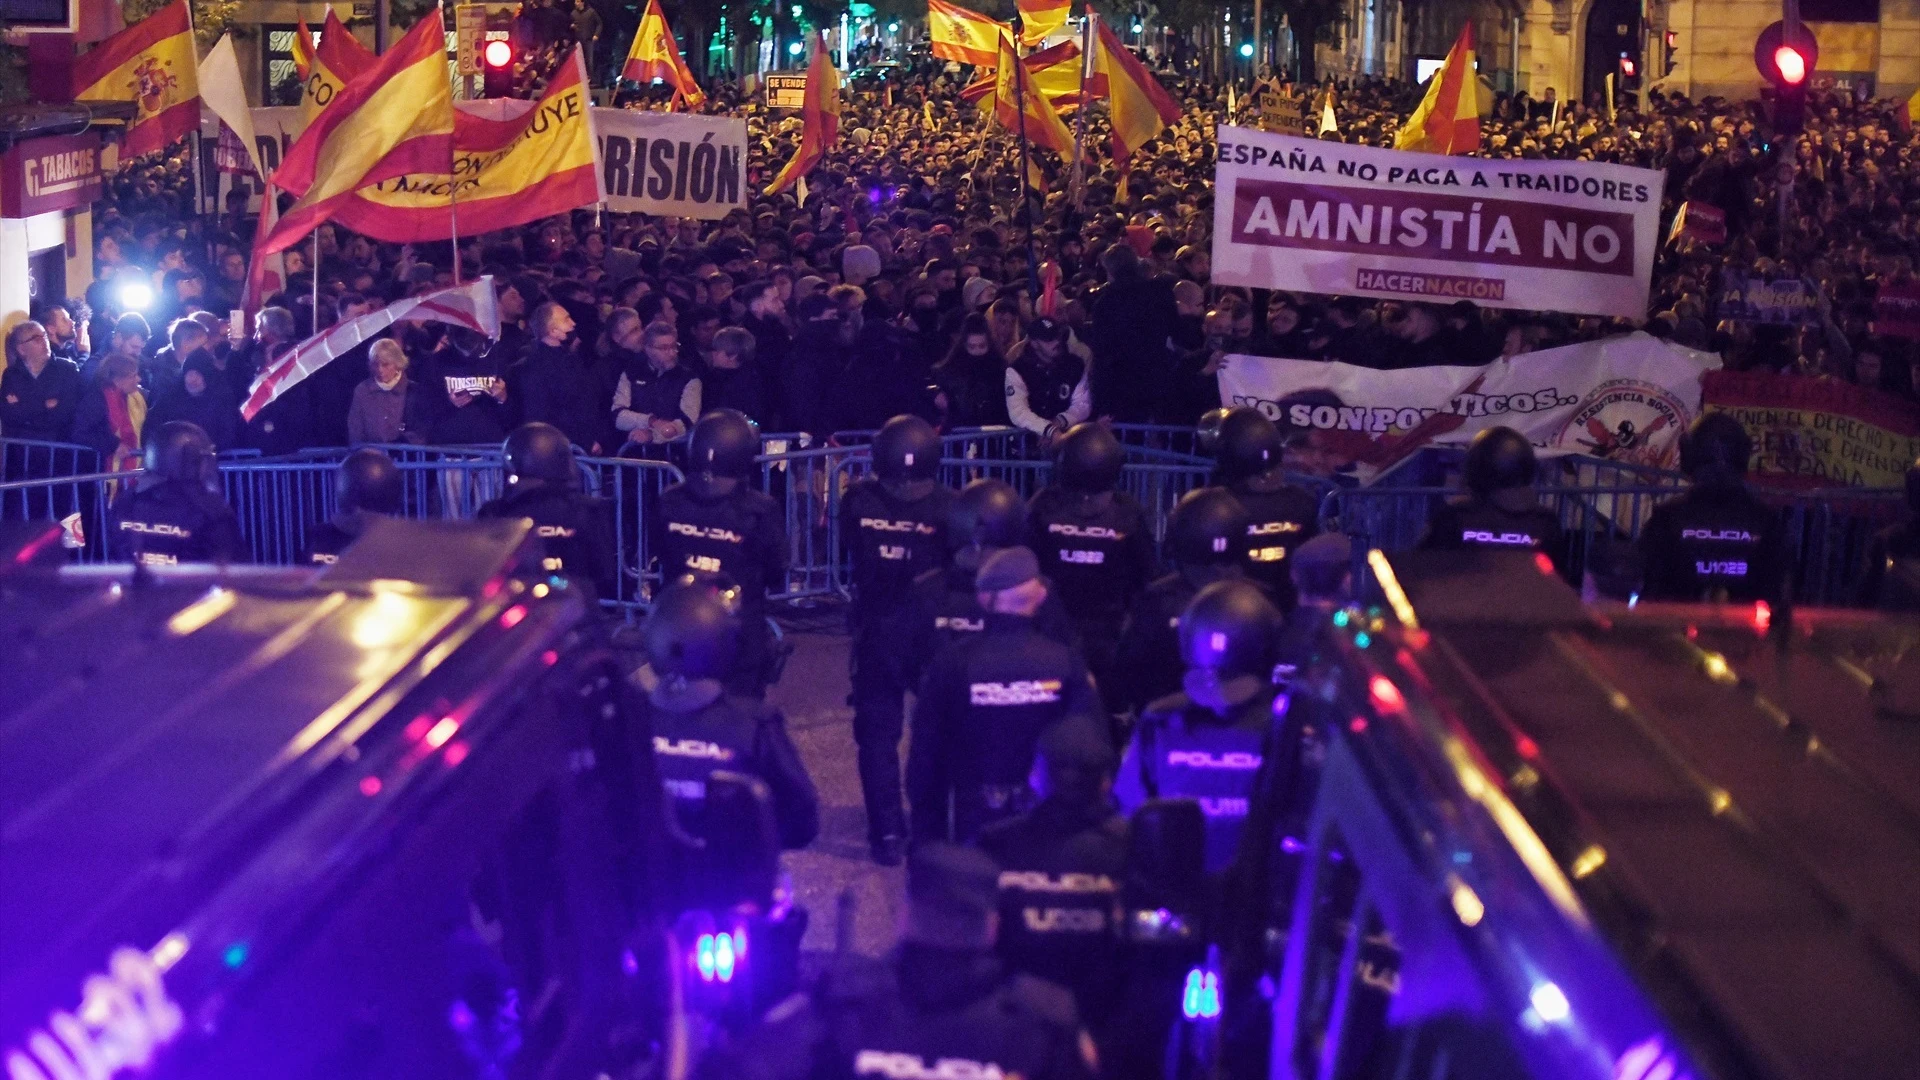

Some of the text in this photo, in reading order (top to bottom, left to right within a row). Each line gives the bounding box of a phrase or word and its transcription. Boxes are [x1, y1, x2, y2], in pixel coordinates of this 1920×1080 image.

[769, 78, 806, 89] SE VENDE
[42, 148, 94, 184] TABACOS
[598, 132, 740, 204] RISIÓN
[1218, 142, 1649, 203] ESPAÑA NO PAGA A TRAIDORES
[1243, 196, 1621, 264] AMNISTÍA NO
[1289, 403, 1367, 432] SON
[1575, 392, 1679, 428] RESISTENCIA SOCIAL
[120, 521, 182, 535] POLICIA
[1048, 523, 1117, 539] POLICIA
[1463, 530, 1533, 544] POLICIA
[1682, 529, 1752, 542] POLICIA
[997, 870, 1114, 893] POLICIA
[854, 1048, 1004, 1080] POLICIA
